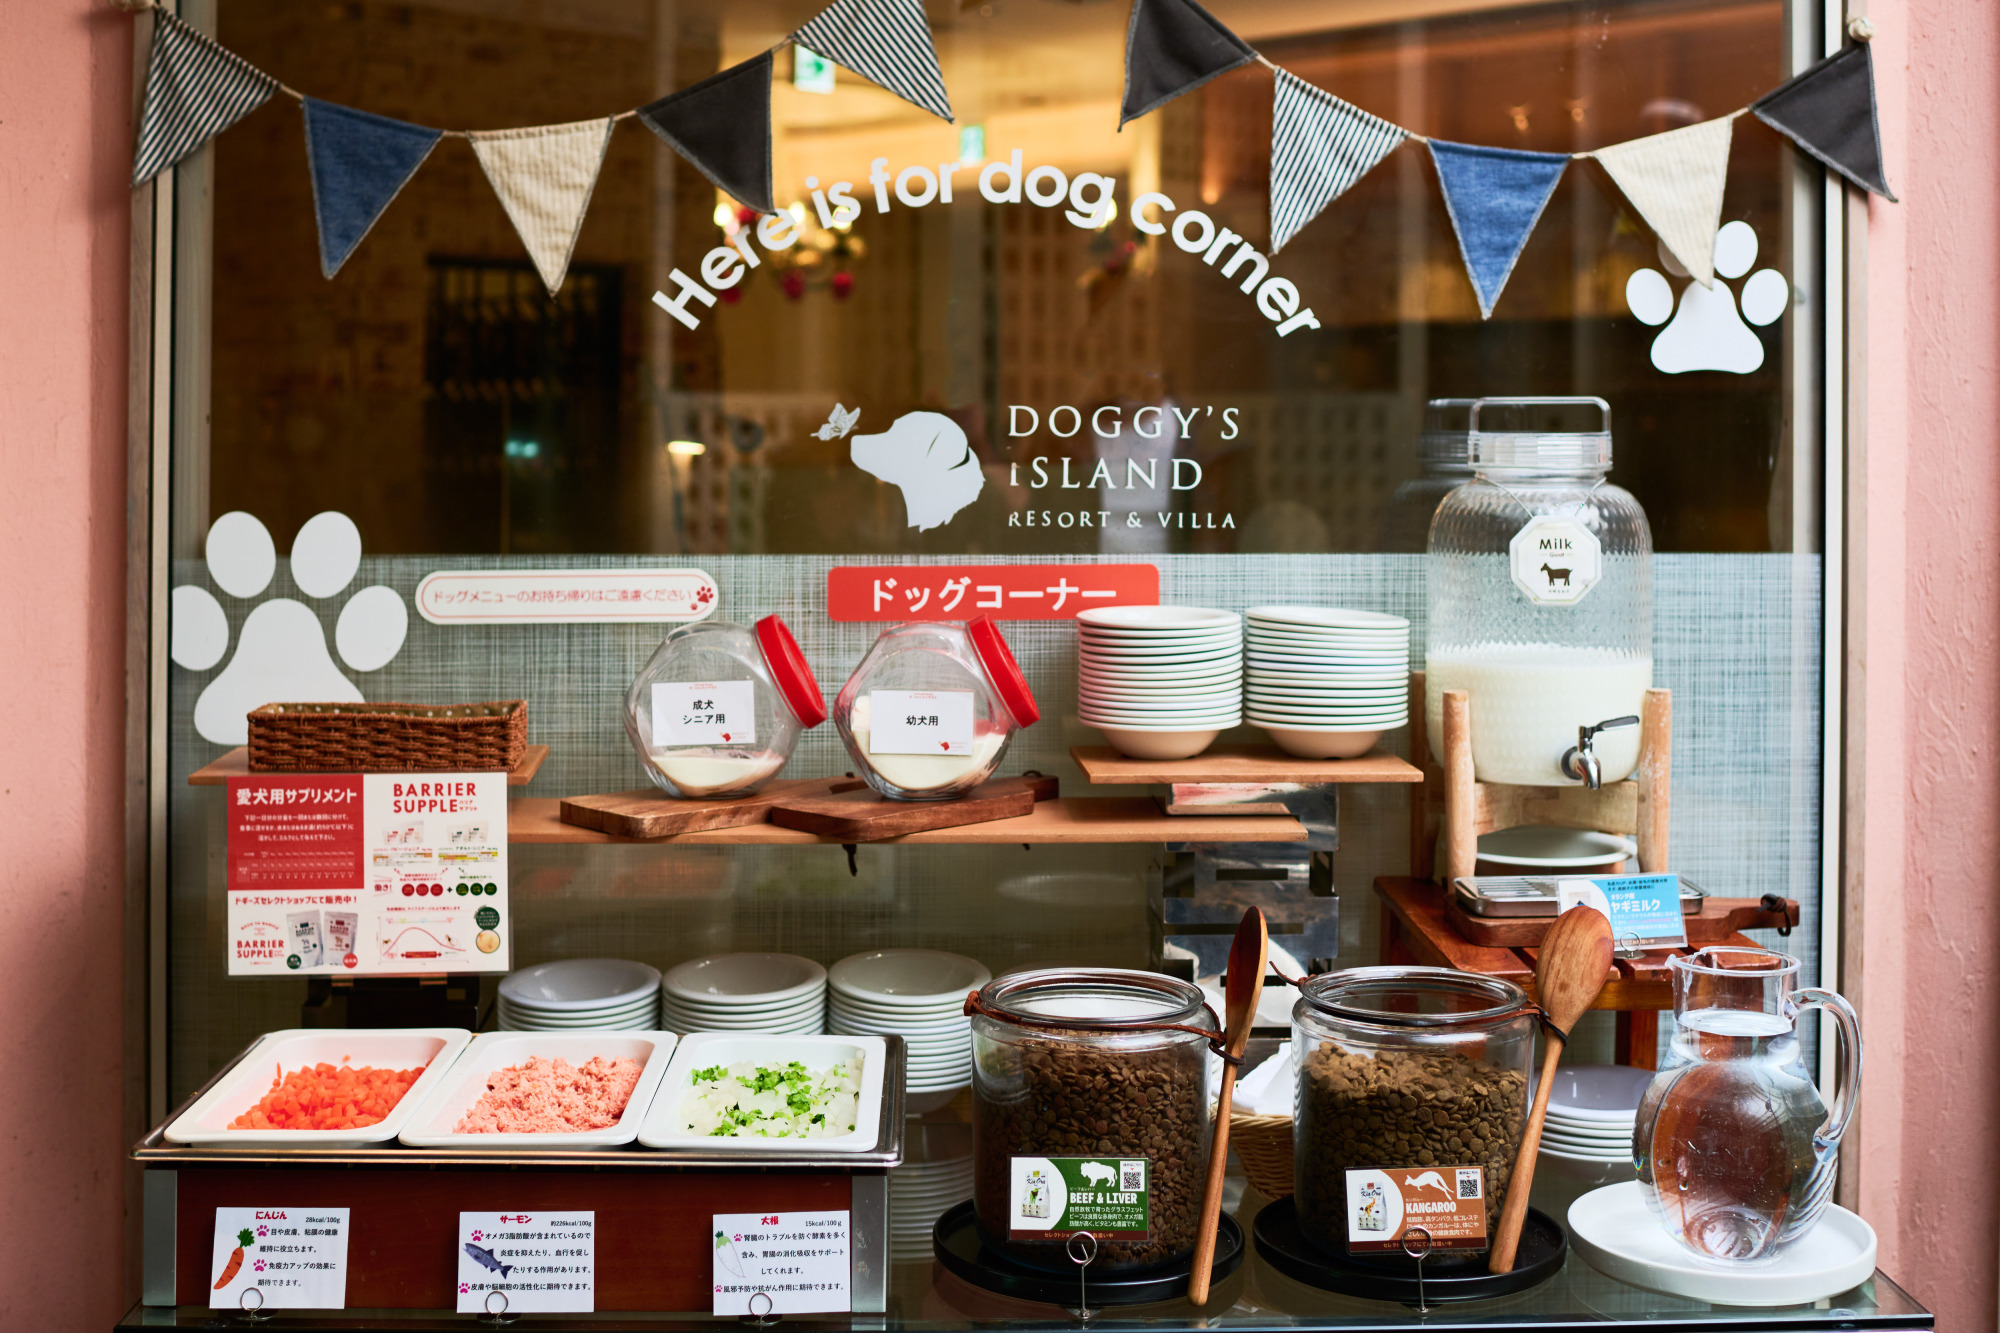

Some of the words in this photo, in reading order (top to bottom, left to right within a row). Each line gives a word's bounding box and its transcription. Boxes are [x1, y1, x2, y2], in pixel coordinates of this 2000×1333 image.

[652, 208, 799, 331] Here
[805, 176, 861, 229] is
[869, 157, 960, 214] for
[978, 148, 1116, 229] dog
[1130, 192, 1321, 337] corner
[1008, 405, 1239, 440] DOGGY'S
[1008, 511, 1111, 528] RESORT
[1126, 512, 1143, 528] &
[1158, 512, 1236, 529] VILLA
[1539, 538, 1572, 550] Milk
[434, 588, 692, 604] ドッグメニューのお持ち帰りはご遠慮ください
[873, 576, 1117, 612] ドッグコーナー
[693, 700, 714, 710] 成犬
[683, 714, 725, 725] シニア用
[906, 715, 939, 726] 幼犬用
[393, 783, 477, 797] BARRIER
[236, 788, 357, 806] 愛犬用サプリメント
[393, 799, 457, 813] SUPPLE
[235, 895, 357, 905] ドギーズセレクトショップにて販売中！
[1611, 899, 1660, 913] ヤギミルク
[237, 940, 284, 949] BARRIER
[237, 950, 273, 959] SUPPLE
[1070, 1192, 1094, 1204] BEEF
[1096, 1192, 1104, 1204] &
[1106, 1192, 1138, 1204] LIVER
[1406, 1201, 1456, 1214] KANGAROO
[255, 1211, 287, 1220] にんじん
[500, 1215, 532, 1224] サーモン
[761, 1216, 779, 1225] 大根
[485, 1232, 591, 1240] オメガ3脂肪酸が含まれているので
[260, 1245, 317, 1253] 維持に役立ちます。
[269, 1262, 336, 1270] 免疫力アップの効果に
[513, 1266, 591, 1274] たりする作用があります。
[761, 1267, 804, 1275] してくれます。
[258, 1279, 302, 1287] 期待できます。
[723, 1283, 844, 1293] 風邪予防や抗がん作用に期待できます。
